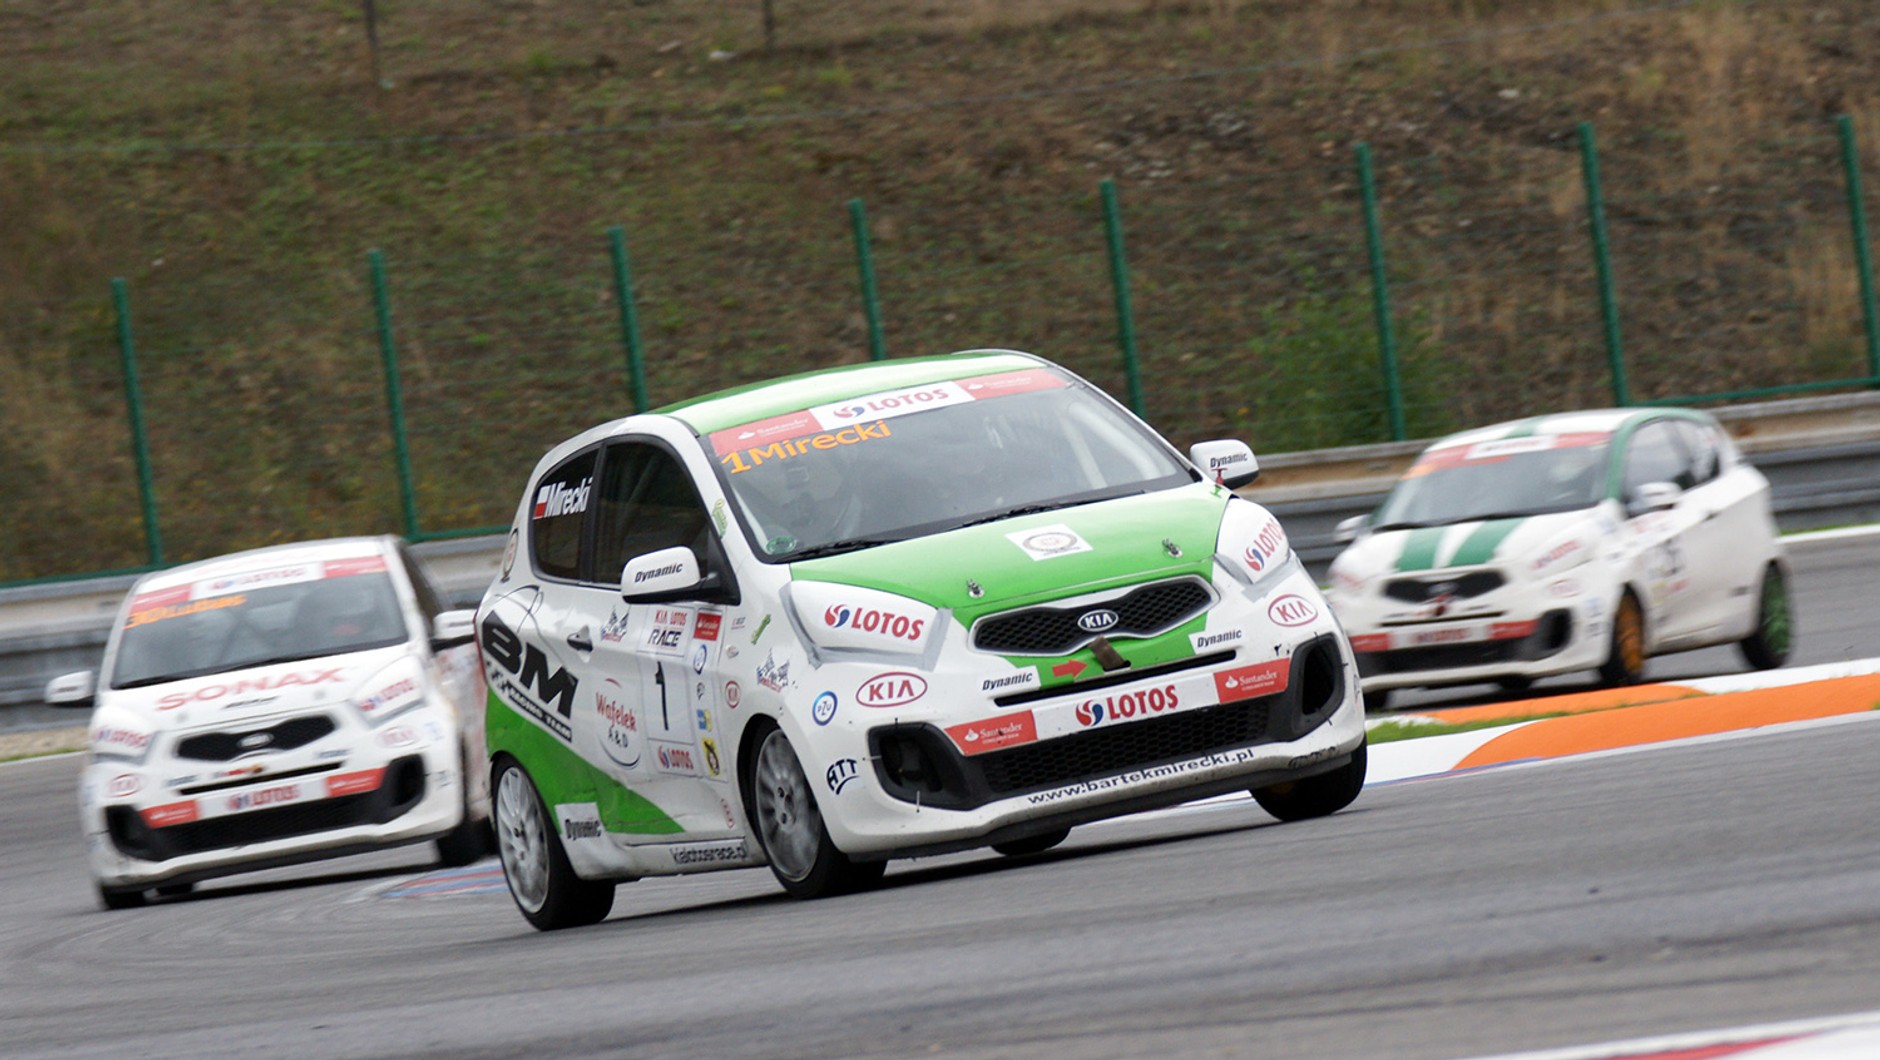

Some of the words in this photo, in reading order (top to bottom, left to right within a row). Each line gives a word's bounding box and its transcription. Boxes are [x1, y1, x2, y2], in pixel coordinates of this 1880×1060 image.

[867, 388, 949, 412] LOTOS
[1210, 450, 1248, 469] Dynamic
[546, 476, 594, 518] Mirecki
[1256, 516, 1285, 558] LOTOS
[634, 562, 683, 584] Dynamic
[655, 609, 667, 623] KIA
[1085, 613, 1113, 628] KIA
[1277, 600, 1313, 622] KIA
[851, 607, 924, 641] LOTOS
[648, 628, 682, 647] RACE
[1197, 630, 1242, 648] Dynamic
[482, 610, 579, 720] BM
[153, 666, 347, 712] SONAX
[868, 679, 914, 702] KIA
[982, 671, 1033, 692] Dynamic
[655, 660, 669, 731] 1
[1107, 684, 1179, 720] LOTOS
[667, 747, 694, 770] LOTOS
[1028, 749, 1255, 804] www.bartekmirecki.pl
